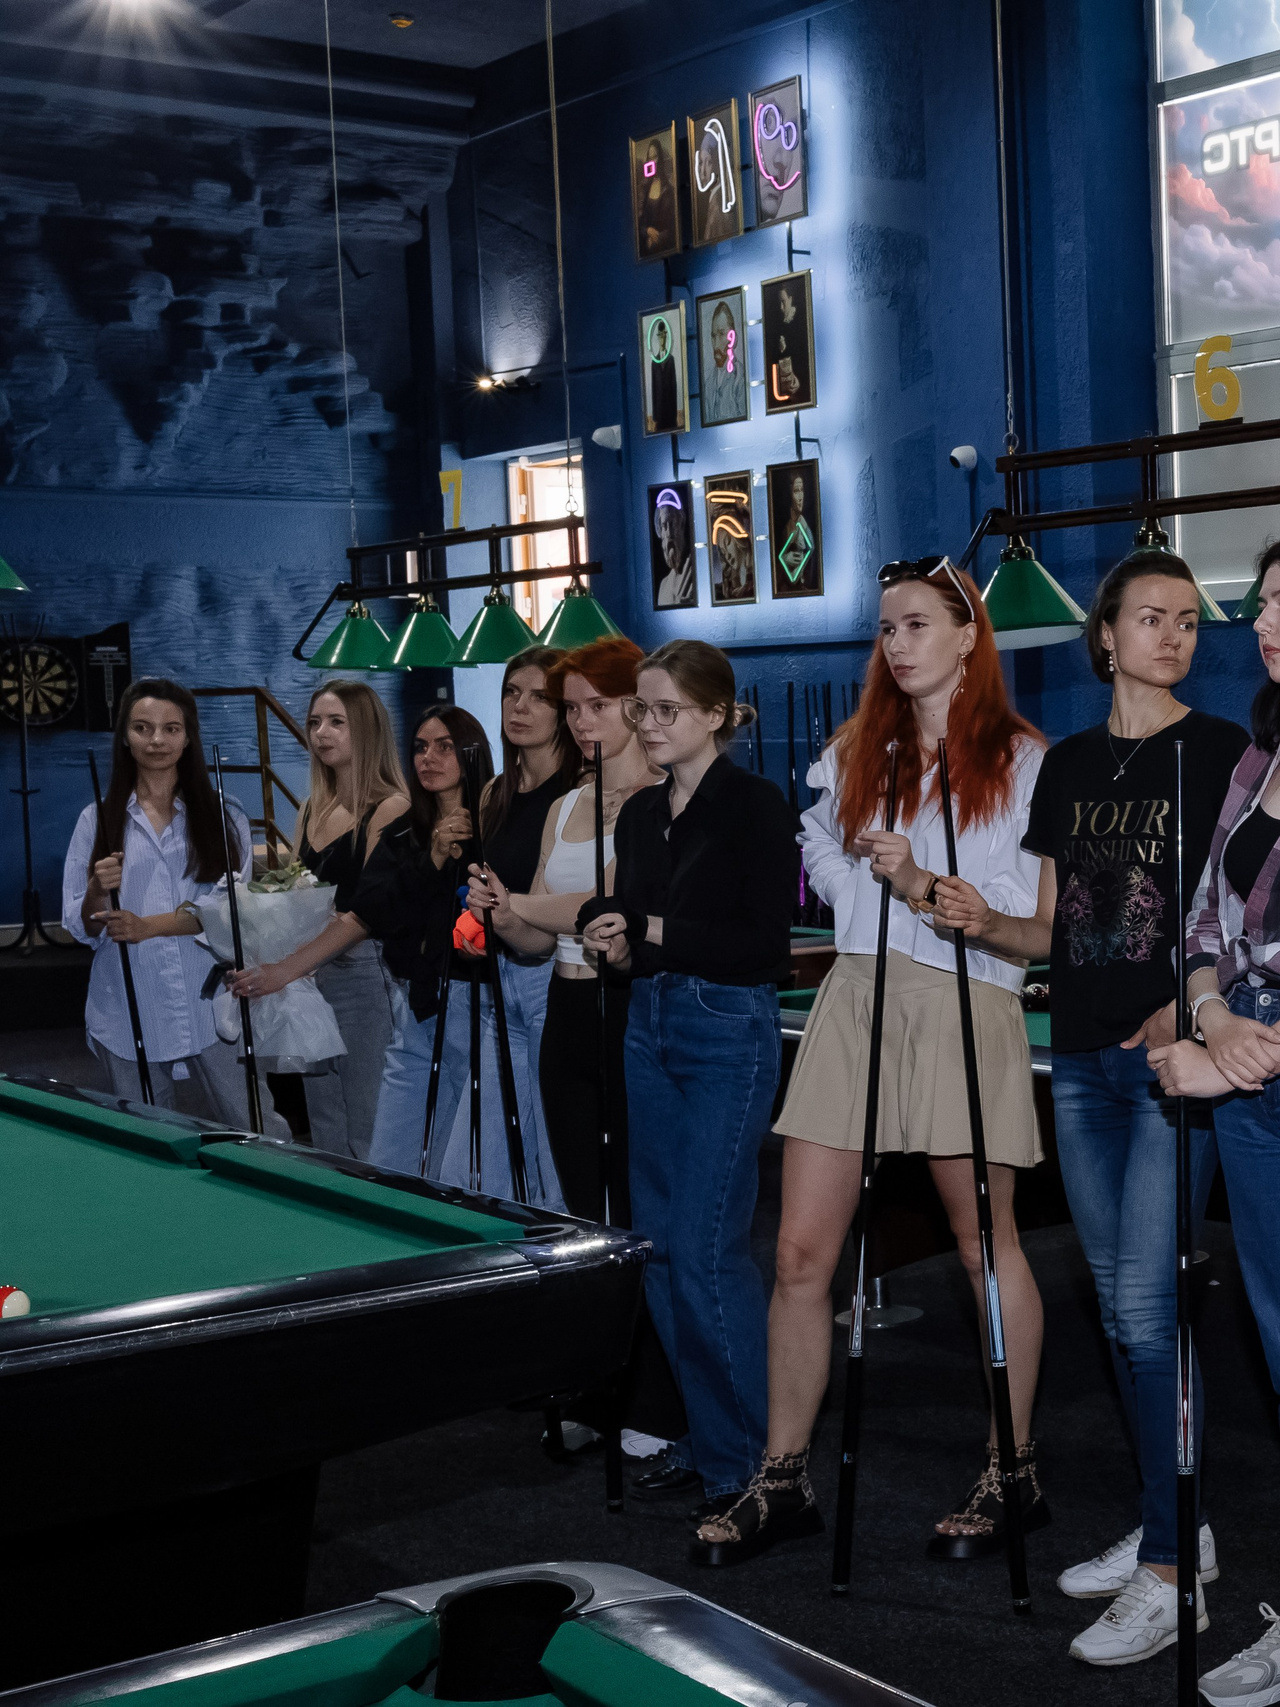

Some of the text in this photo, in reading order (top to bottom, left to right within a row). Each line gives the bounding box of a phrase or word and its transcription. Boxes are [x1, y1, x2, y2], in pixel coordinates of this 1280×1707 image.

[1194, 334, 1241, 421] 6
[438, 469, 463, 530] 7
[1069, 799, 1170, 837] YOUR
[1063, 838, 1165, 865] SUNSHINE
